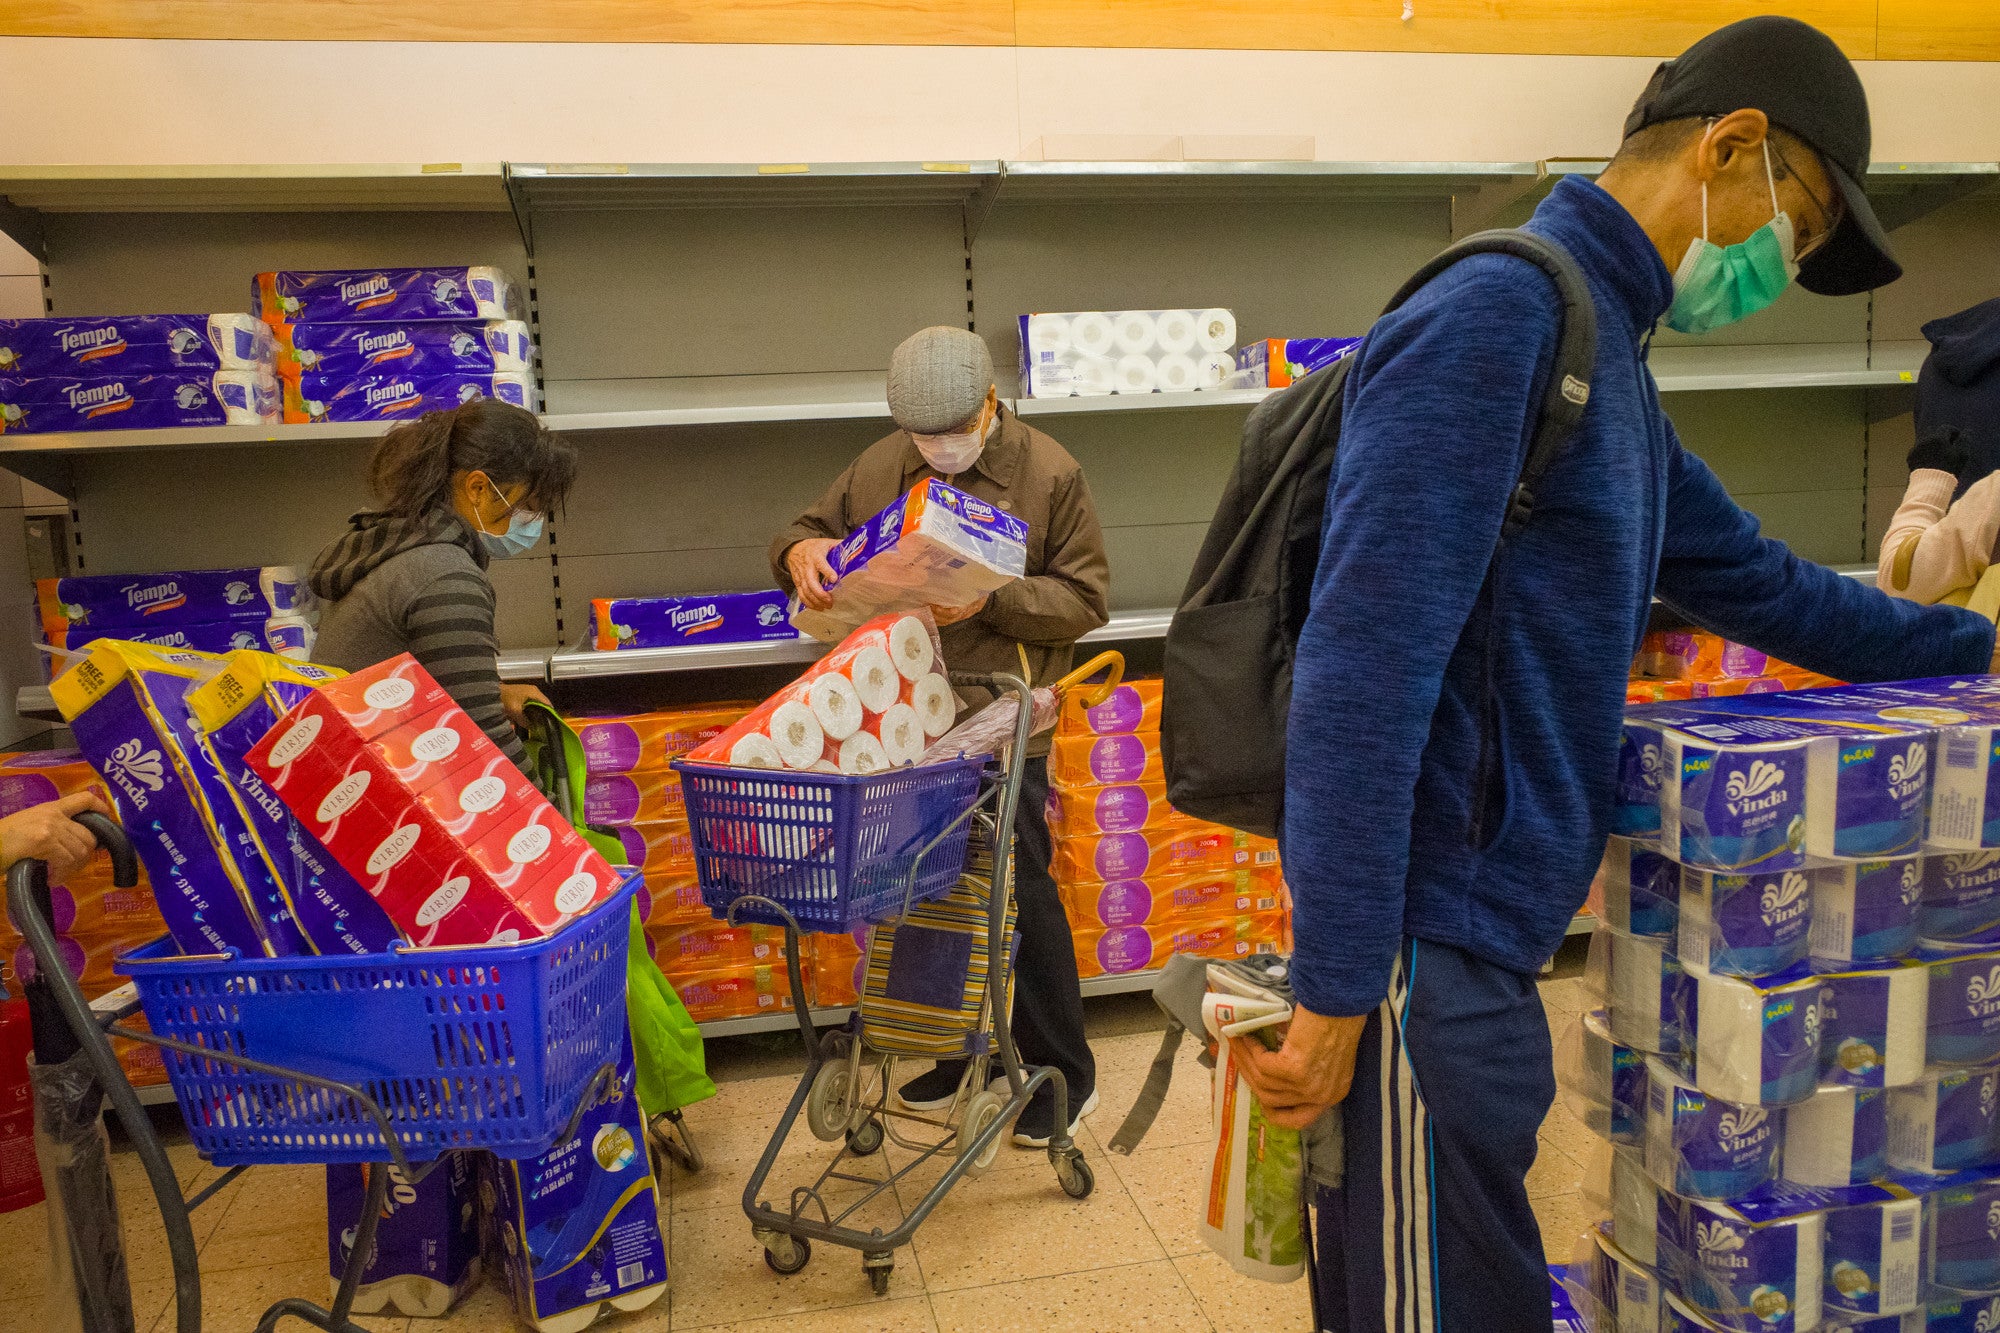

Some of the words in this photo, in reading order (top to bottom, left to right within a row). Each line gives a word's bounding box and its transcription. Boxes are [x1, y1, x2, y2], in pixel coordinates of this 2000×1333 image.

[334, 277, 389, 301] Tempo
[54, 326, 117, 352] Tempo
[351, 331, 406, 353] Tempo
[62, 382, 125, 408] Tempo
[360, 381, 414, 405] Tempo
[962, 496, 992, 514] Tempo
[120, 581, 178, 607] Tempo
[665, 604, 716, 628] Tempo
[223, 673, 244, 694] FREE
[370, 682, 405, 702] VIRJOY
[275, 723, 312, 759] VIRJOY
[417, 732, 451, 754] VIRJOY
[587, 732, 611, 745] SELECT
[104, 758, 149, 811] Vinda
[238, 769, 285, 824] Vinda
[323, 779, 360, 814] VIRJOY
[464, 781, 498, 806] VIRJOY
[1726, 790, 1788, 817] Vinda
[372, 832, 411, 867] VIRJOY
[512, 830, 543, 856] VIRJOY
[1170, 849, 1206, 861] JUMBO
[422, 885, 461, 919] VIRJOY
[559, 880, 589, 906] VIRJOY
[1173, 895, 1209, 907] JUMBO
[717, 983, 738, 991] 2000g
